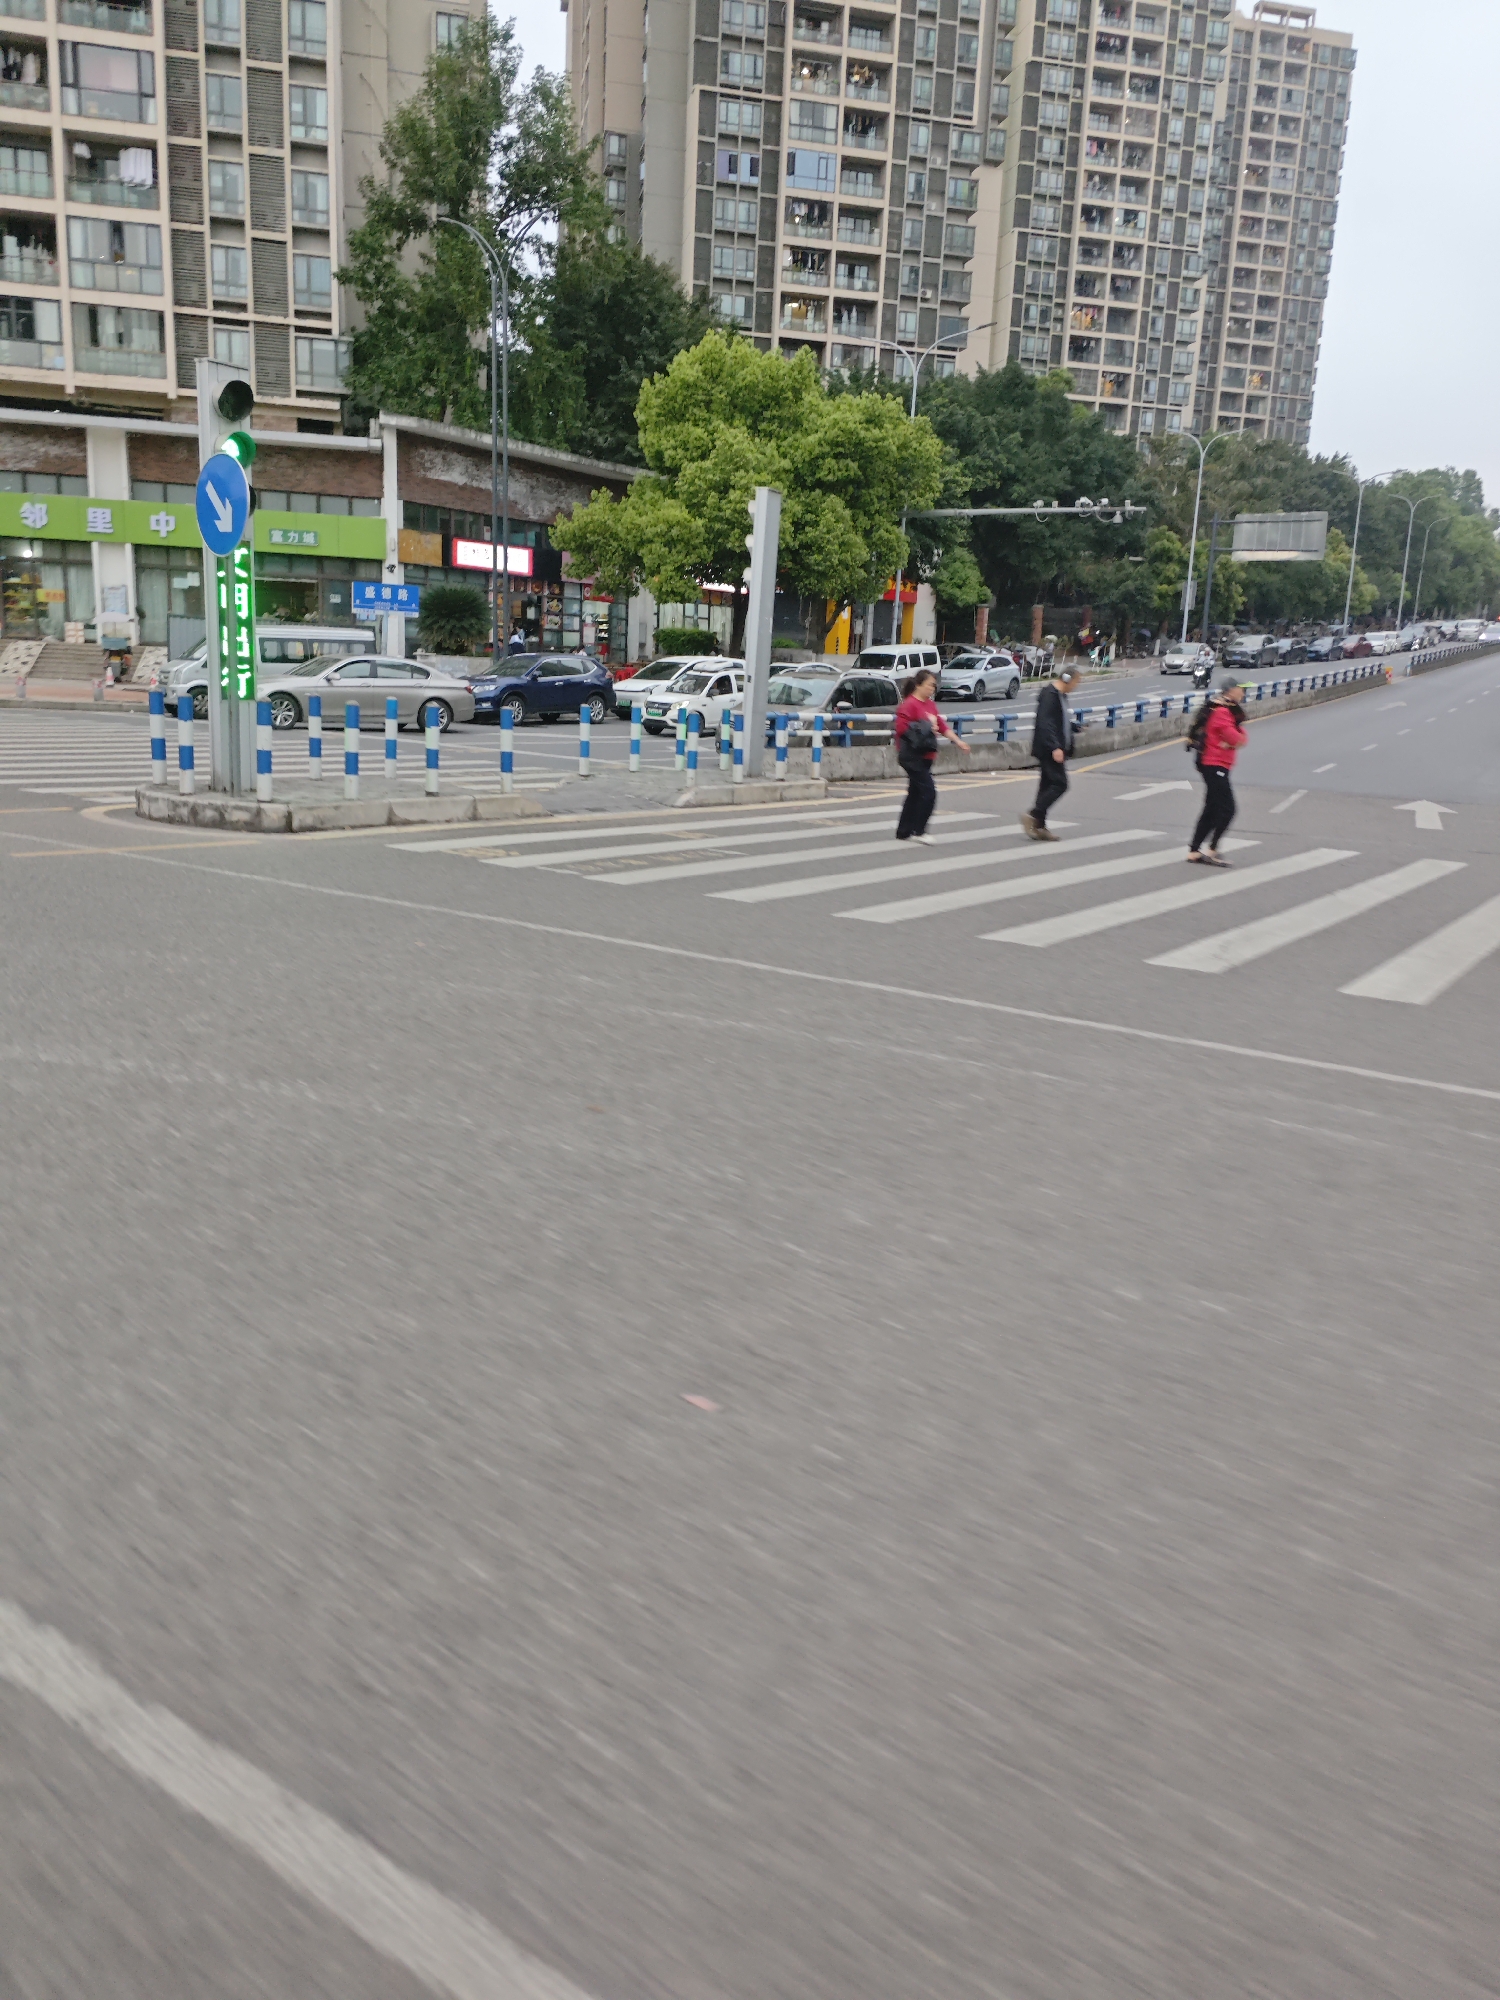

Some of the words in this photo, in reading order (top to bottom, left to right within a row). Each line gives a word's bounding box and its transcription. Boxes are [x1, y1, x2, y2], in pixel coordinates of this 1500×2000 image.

[271, 529, 315, 544] 富力城
[364, 585, 409, 602] 盛德路
